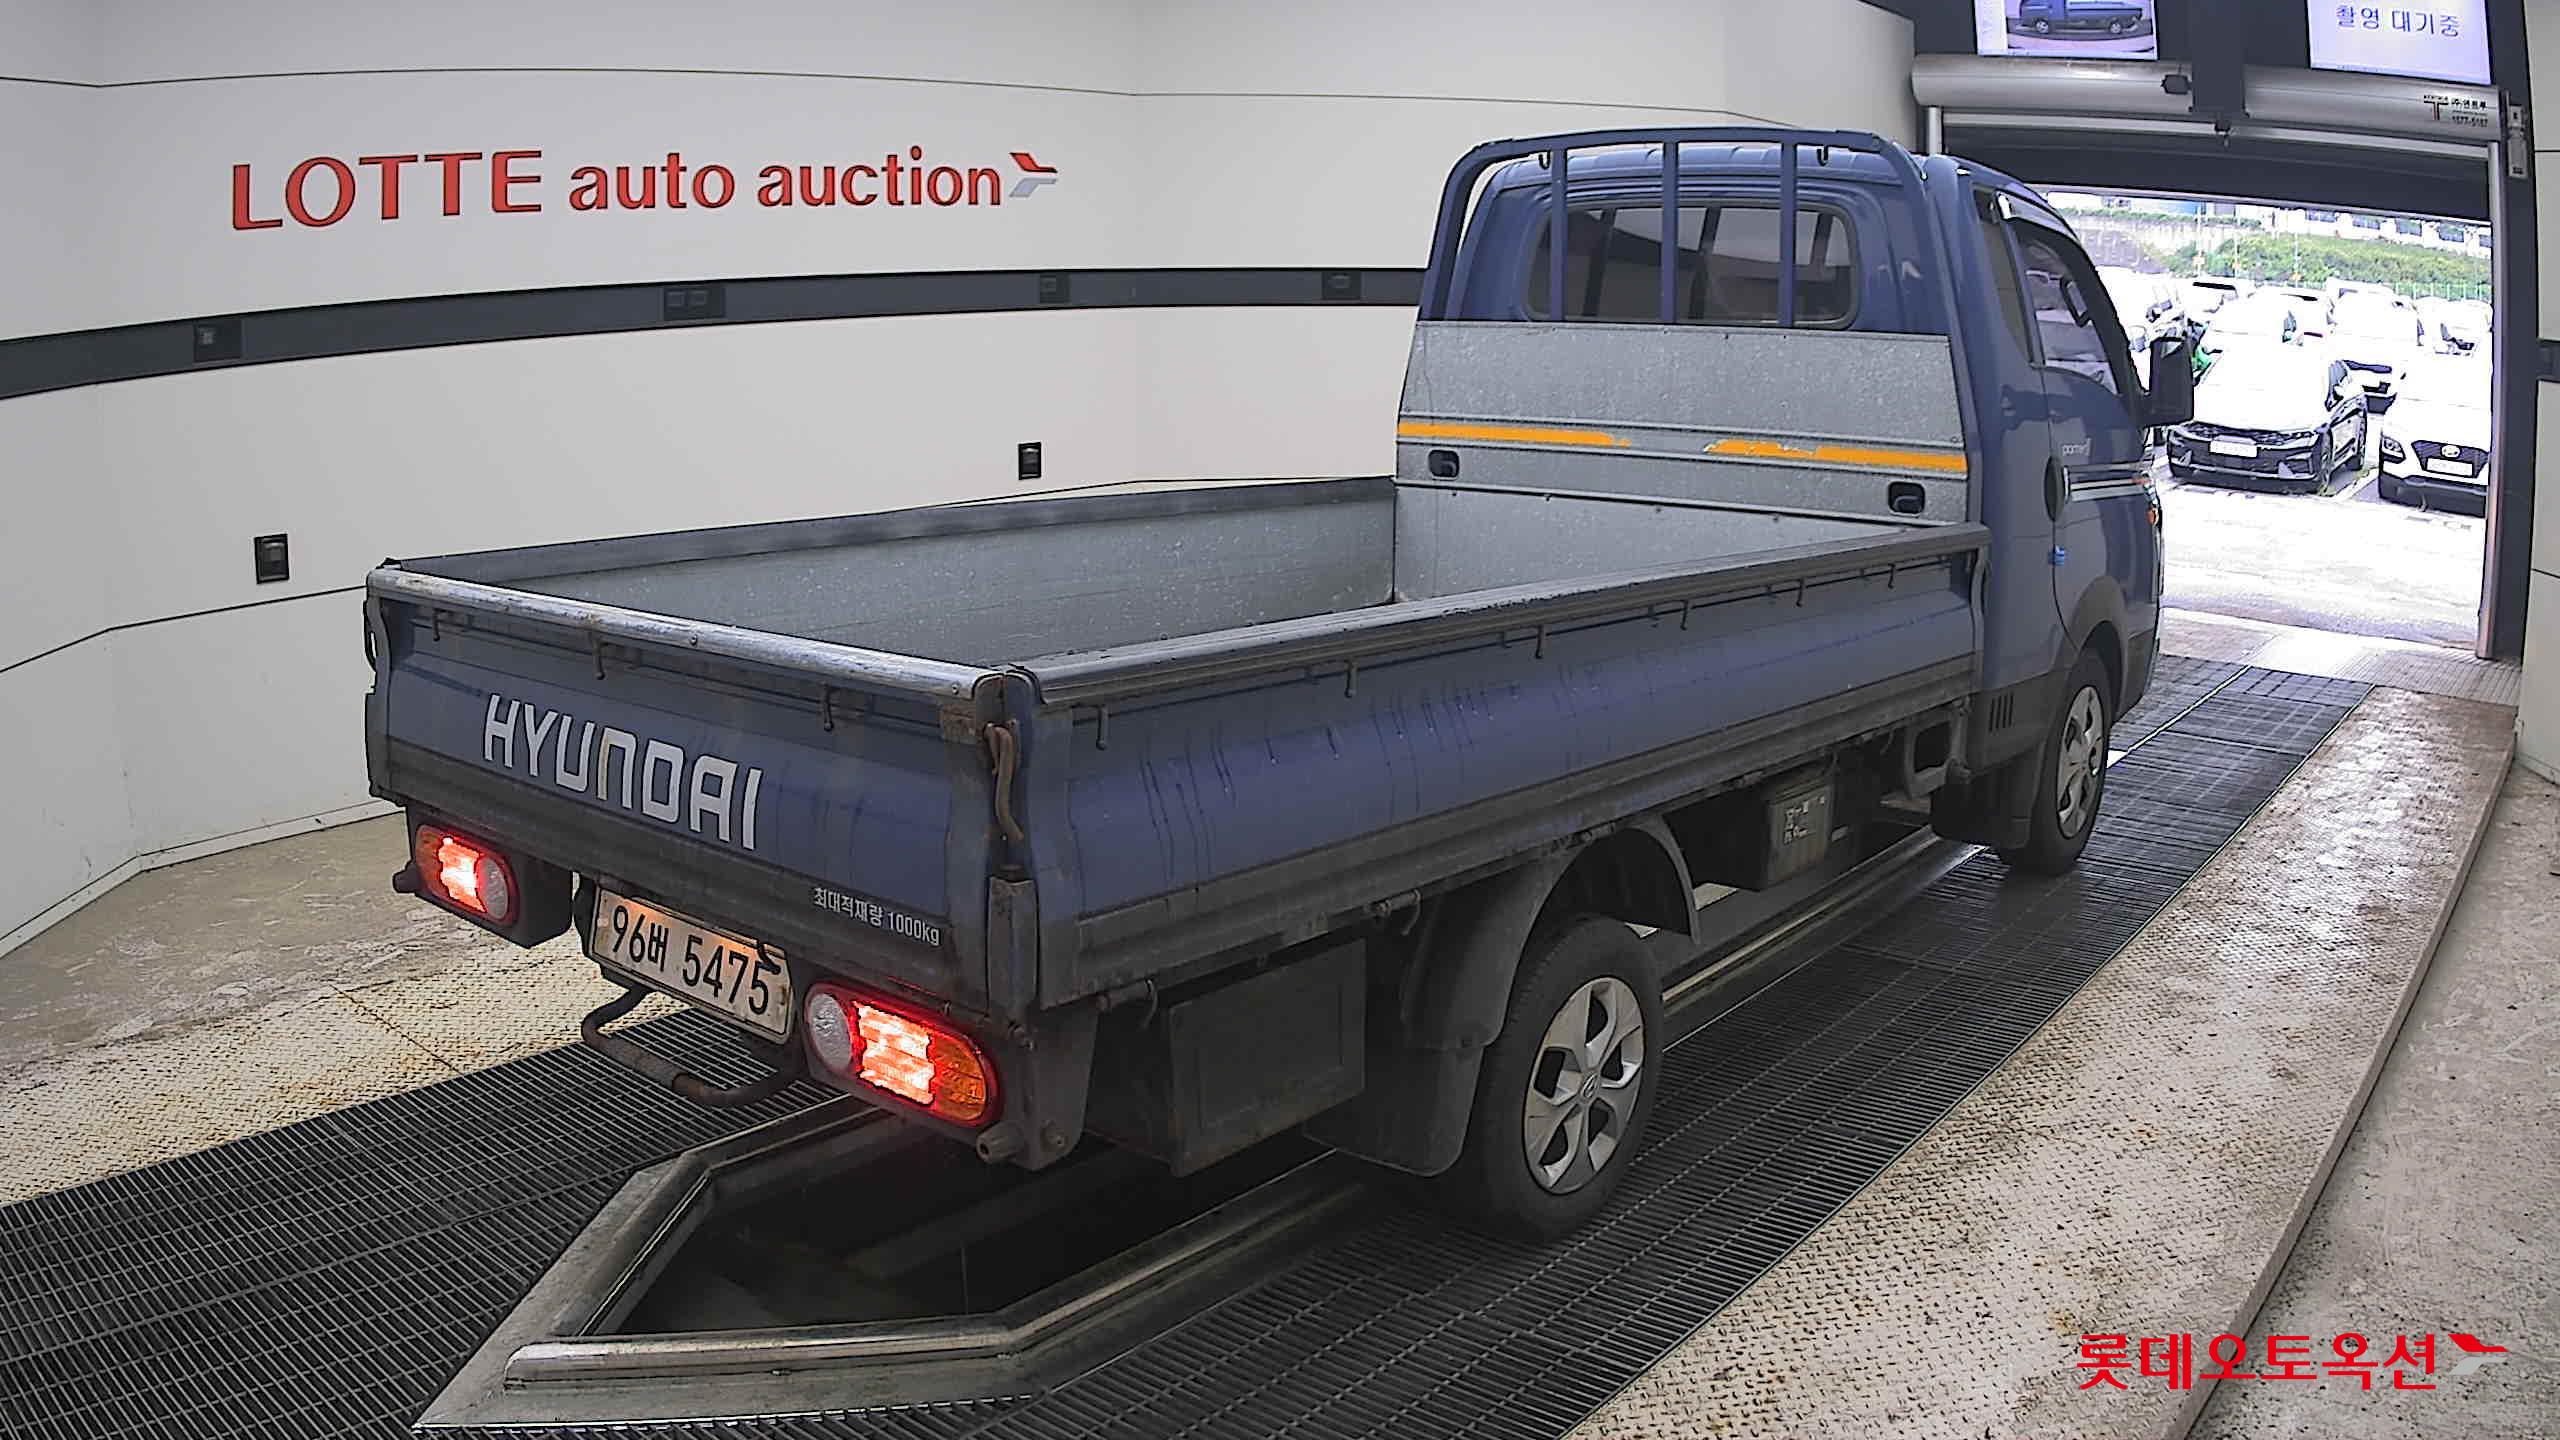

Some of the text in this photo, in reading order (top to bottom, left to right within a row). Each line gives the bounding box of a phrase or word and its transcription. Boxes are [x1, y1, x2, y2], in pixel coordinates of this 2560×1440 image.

[2336, 5, 2460, 38] 촬영 대기중
[232, 146, 1002, 231] LOTTE auto auction
[483, 693, 763, 851] HYUNDAI
[814, 887, 940, 946] 최대적재량 1000kg
[612, 904, 770, 1015] 96버 5475
